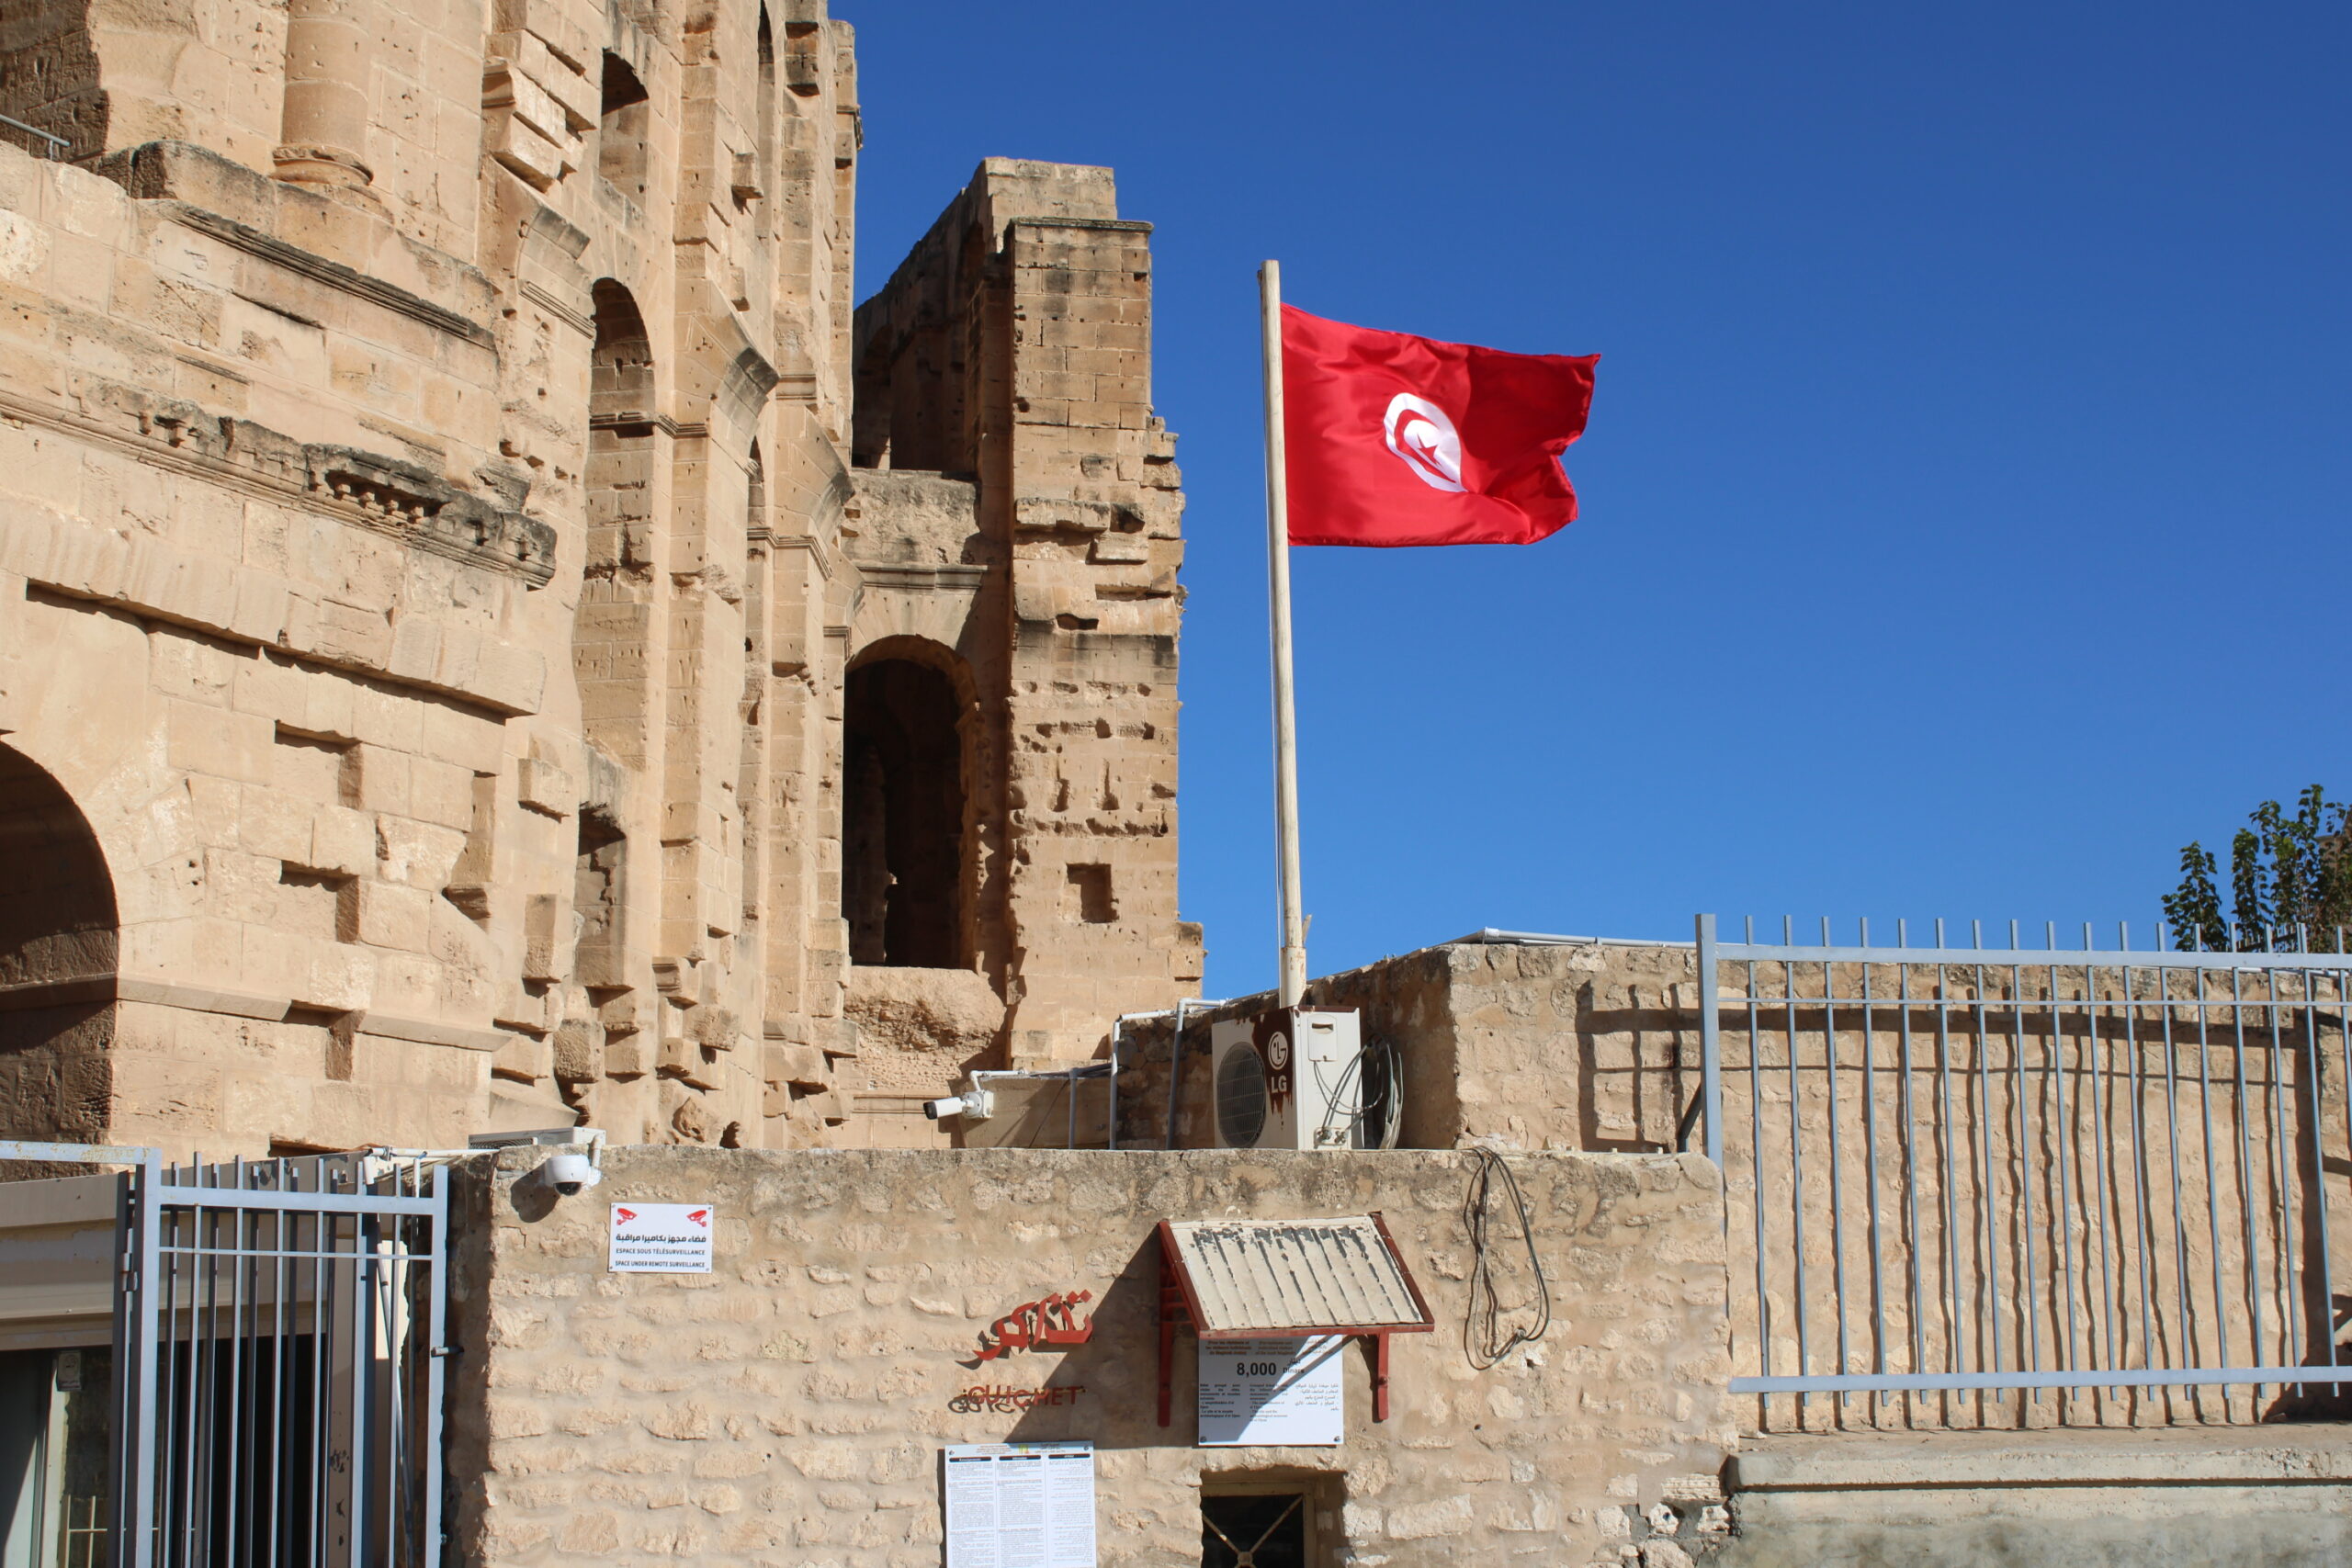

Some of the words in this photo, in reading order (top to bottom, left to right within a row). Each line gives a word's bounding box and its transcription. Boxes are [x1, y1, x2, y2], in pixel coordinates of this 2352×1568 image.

[1271, 1075, 1287, 1093] LG
[616, 1234, 641, 1244] مراقبة
[641, 1235, 667, 1244] بكاميرا
[667, 1235, 687, 1244] مجهز
[687, 1235, 707, 1243] فضاء
[1237, 1362, 1276, 1377] 8,000
[967, 1384, 1080, 1406] GUICHET
